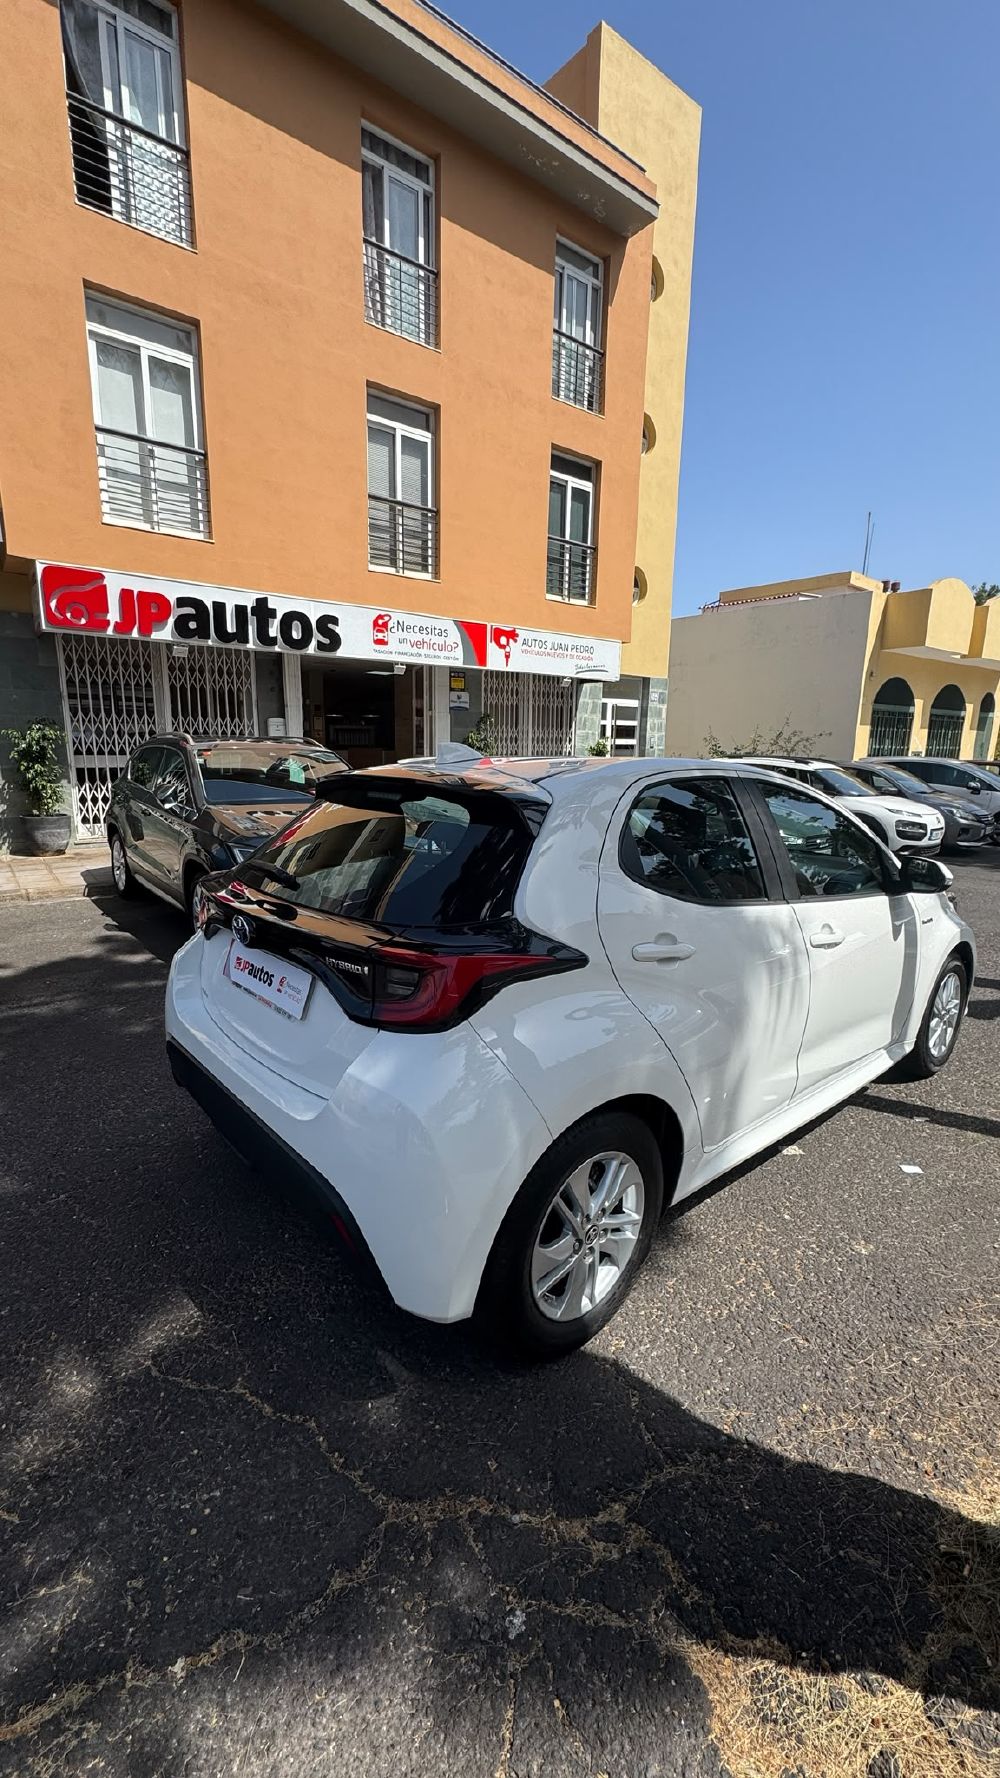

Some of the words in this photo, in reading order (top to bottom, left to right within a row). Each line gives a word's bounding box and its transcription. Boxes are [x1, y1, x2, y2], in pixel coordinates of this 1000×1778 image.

[113, 587, 342, 653] JPautos
[389, 619, 449, 638] ¿Necesitas
[398, 637, 408, 645] un
[408, 638, 459, 653] vehículo?
[521, 638, 548, 650] AUTOS
[549, 641, 569, 653] JUAN
[570, 644, 595, 655] PEDRO
[325, 956, 363, 975] HYBRID
